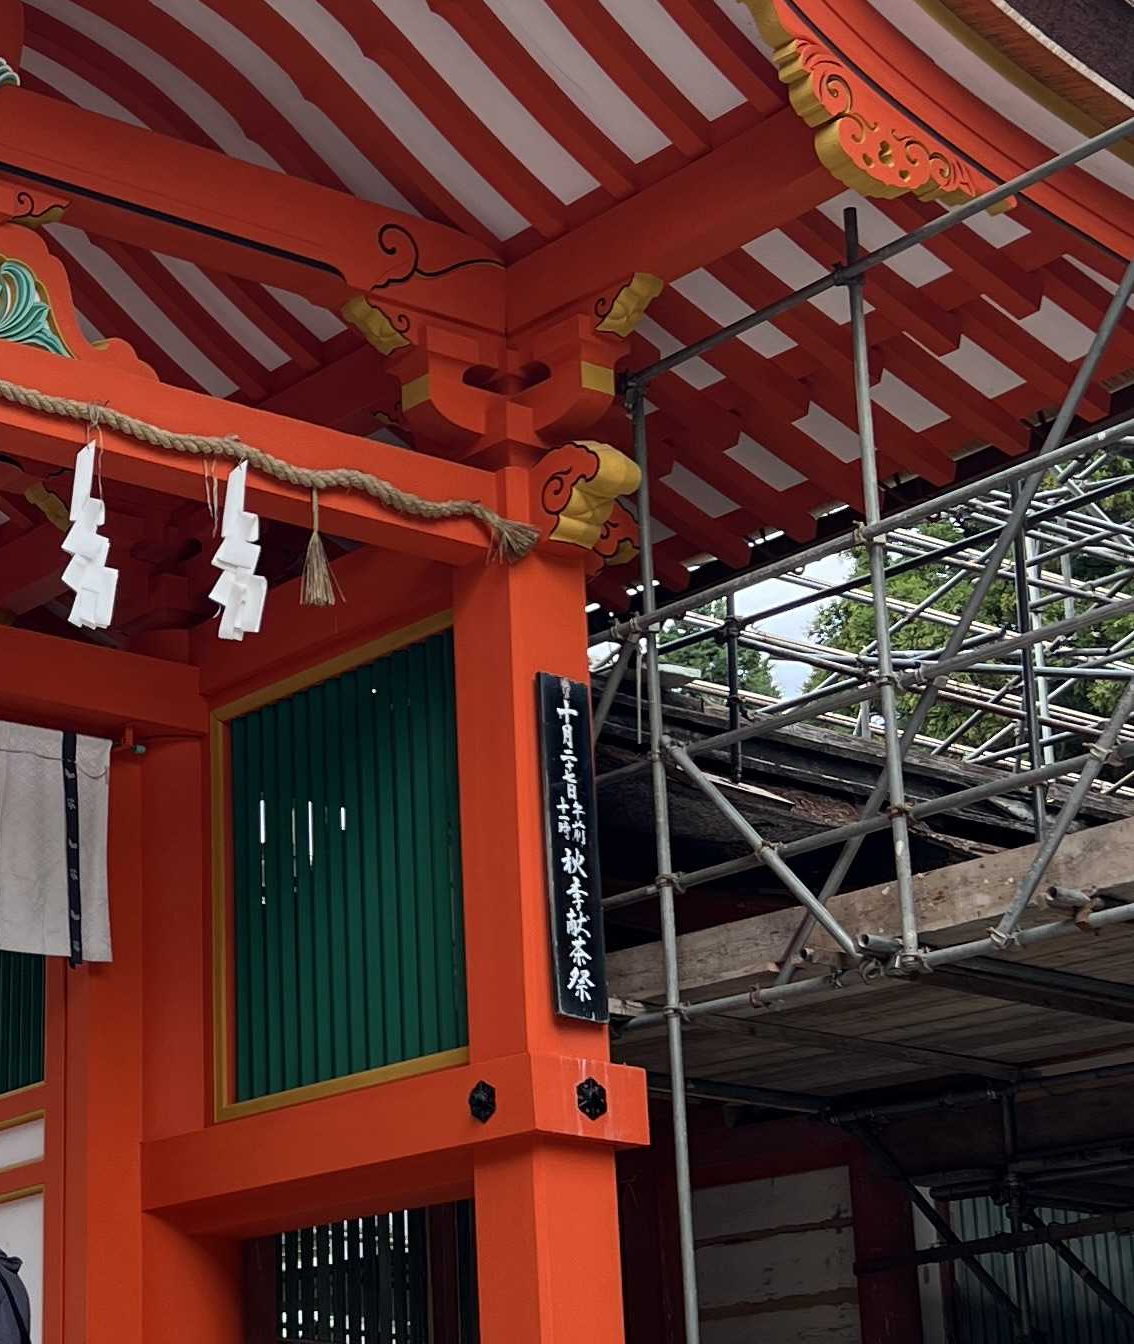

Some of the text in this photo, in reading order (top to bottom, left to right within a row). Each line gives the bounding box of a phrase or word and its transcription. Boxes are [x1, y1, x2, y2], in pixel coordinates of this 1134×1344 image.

[556, 699, 578, 800] 十月二十七日
[561, 847, 595, 1003] 秋季献茶祭
